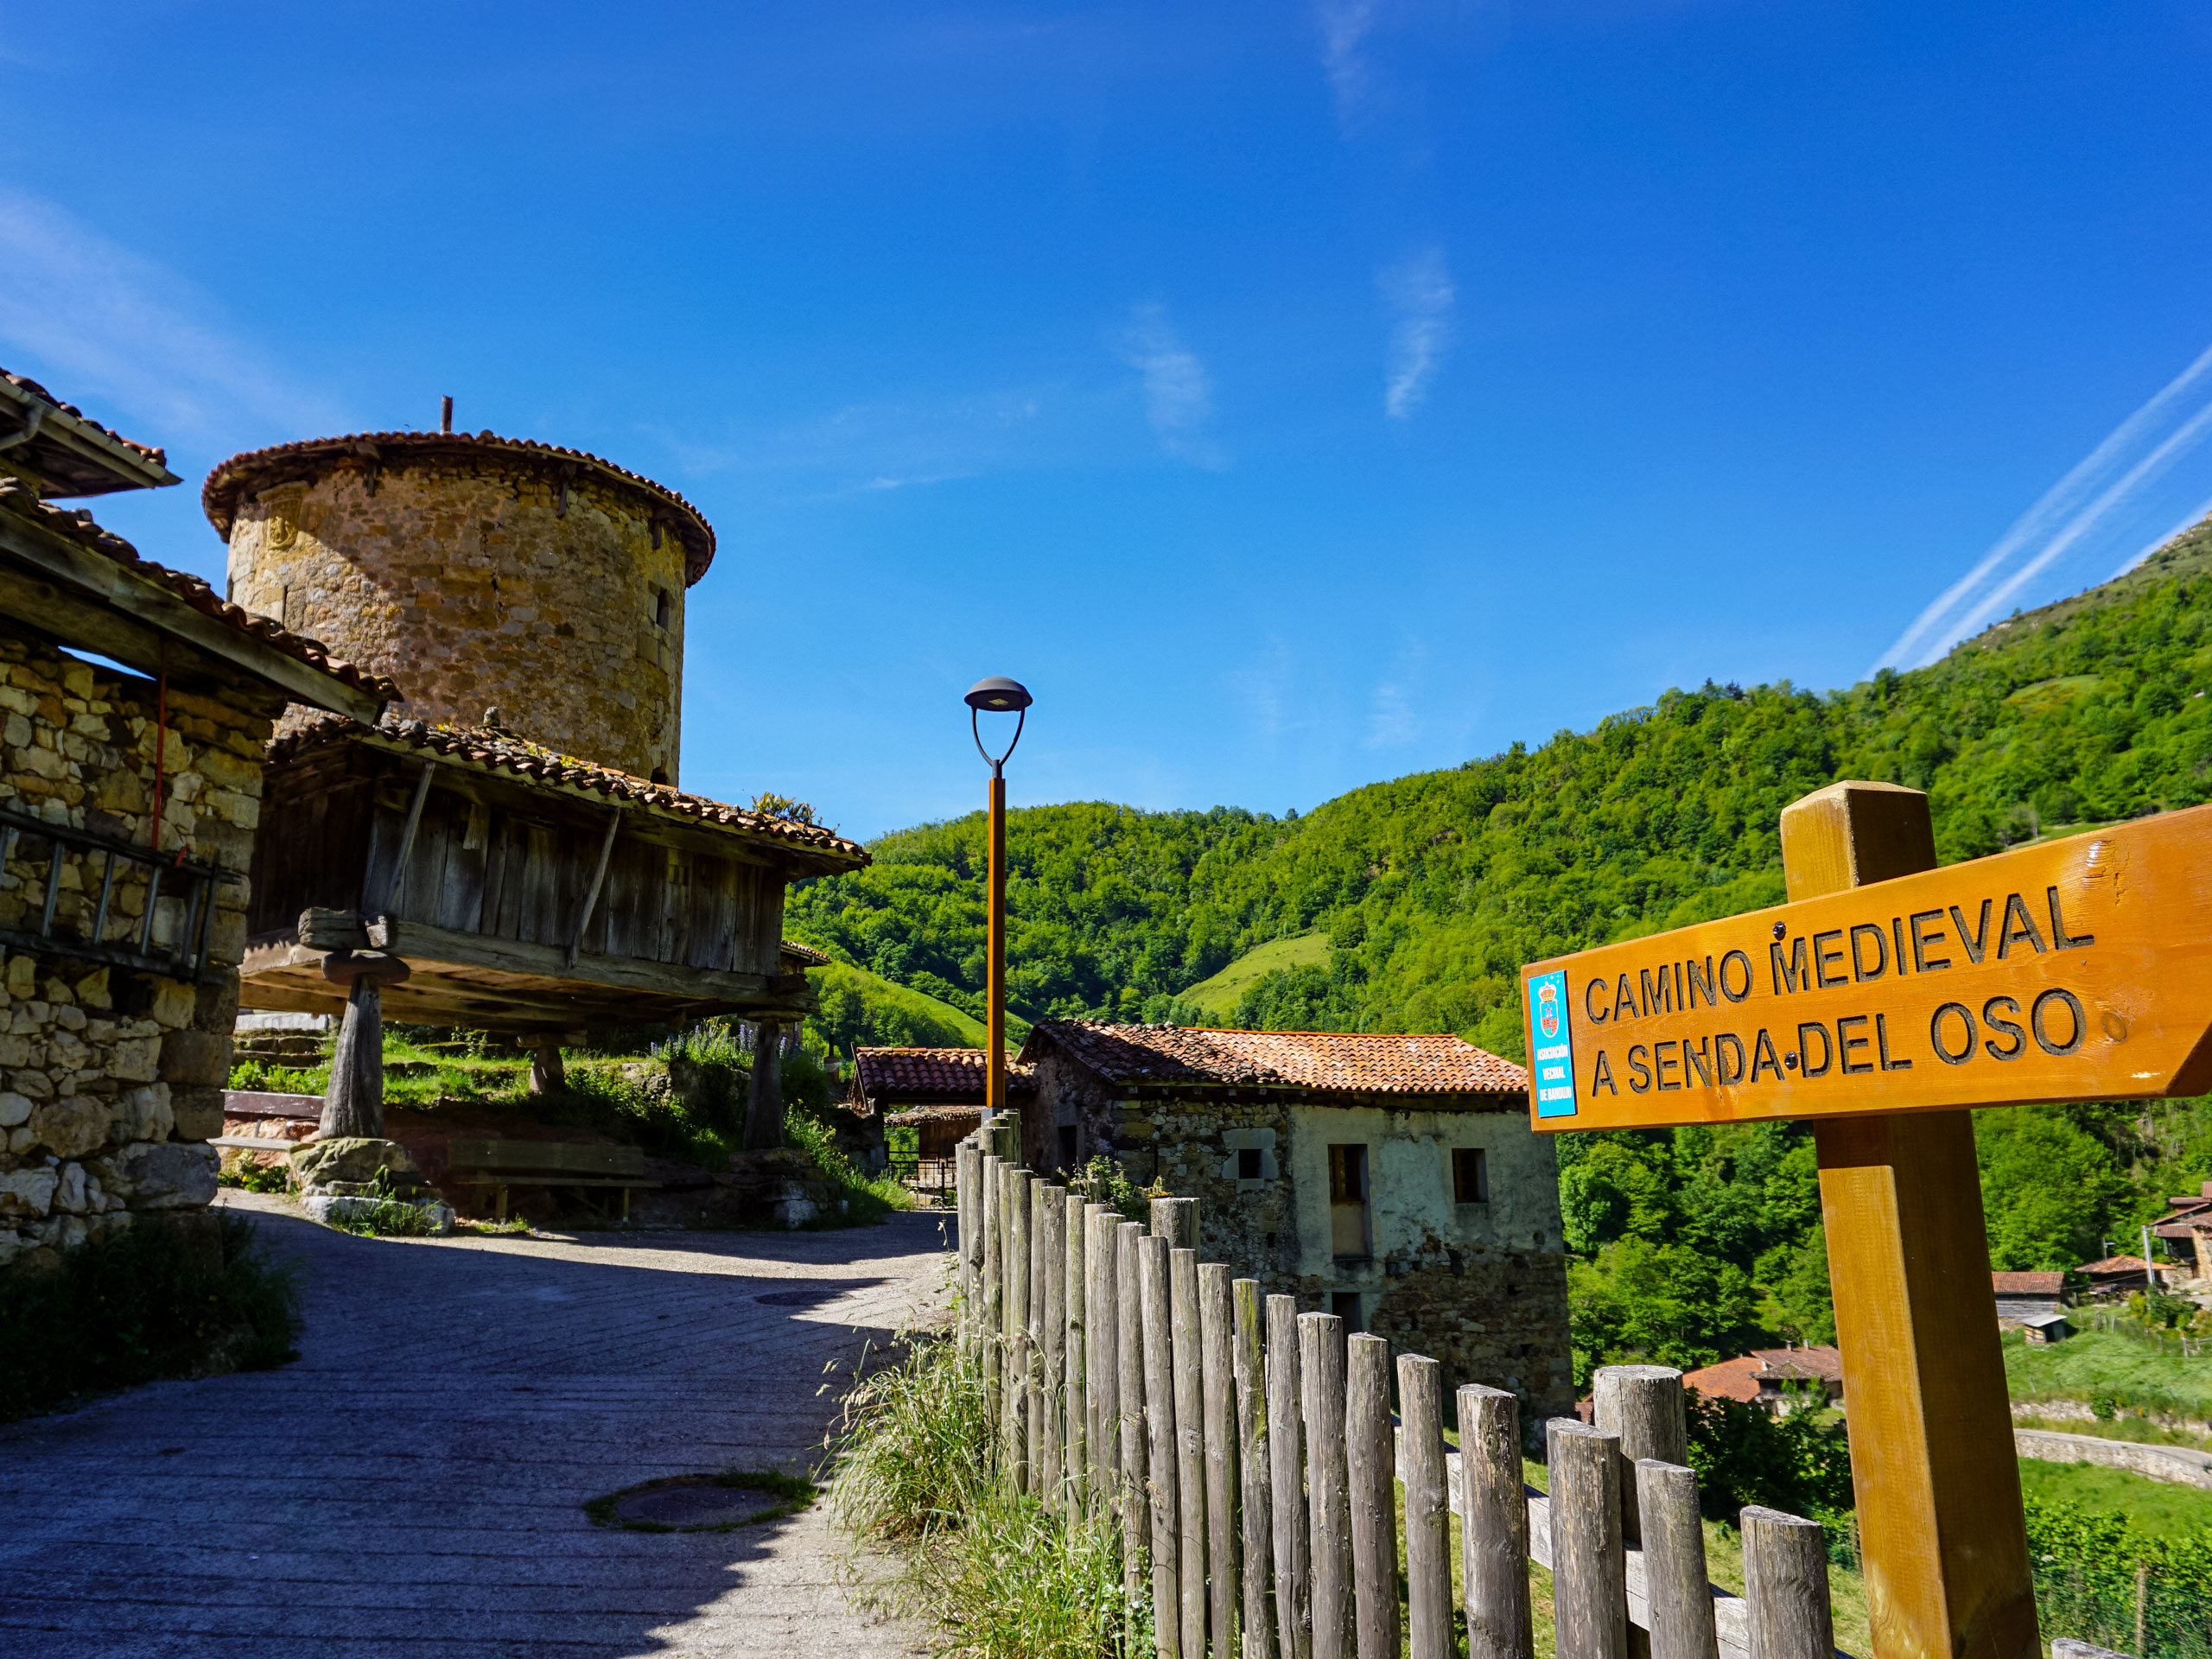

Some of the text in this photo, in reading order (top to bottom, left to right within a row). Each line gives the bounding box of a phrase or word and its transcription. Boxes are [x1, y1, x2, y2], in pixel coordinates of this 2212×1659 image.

[1586, 886, 2094, 1026] CAMINO MEDIEVAL
[1592, 988, 2087, 1097] A SENDA DEL OSO
[1537, 1043, 1568, 1060] ASOCIACIÓN
[1542, 1065, 1566, 1080] VECINAL
[1540, 1089, 1548, 1101] DE
